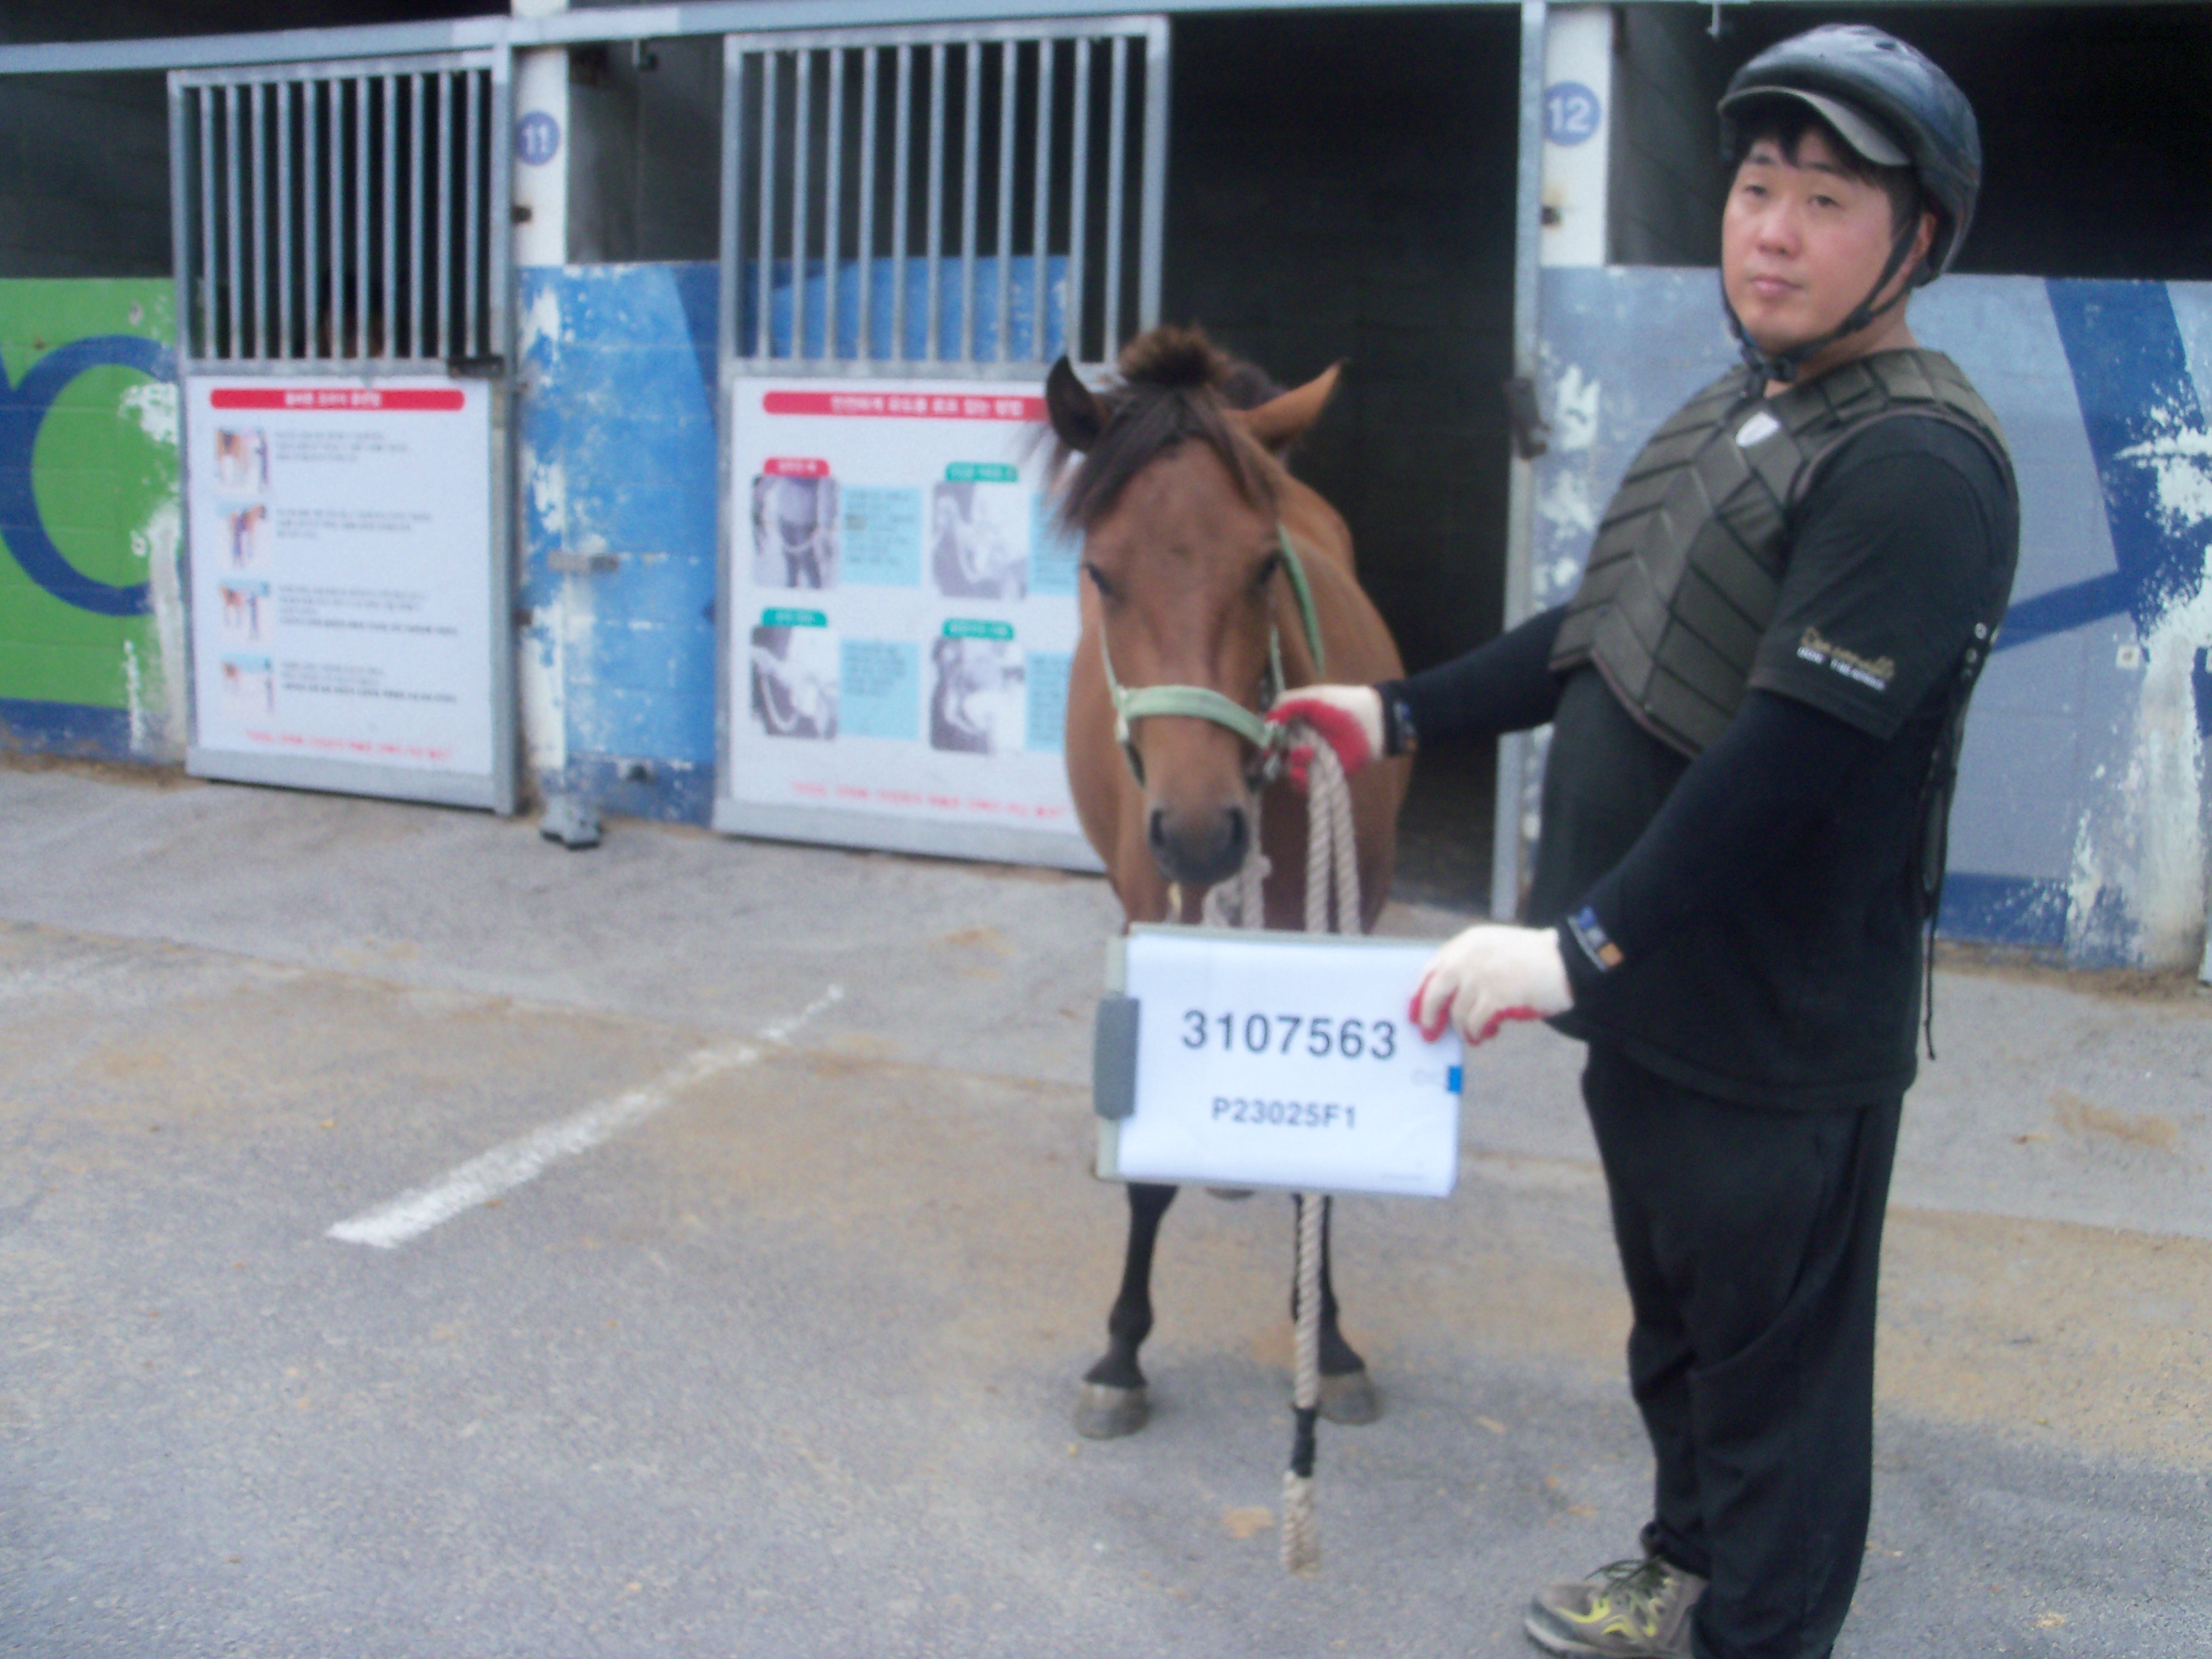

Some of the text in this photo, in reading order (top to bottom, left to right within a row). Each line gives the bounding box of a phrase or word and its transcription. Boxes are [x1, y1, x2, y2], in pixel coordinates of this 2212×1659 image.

[1550, 96, 1590, 132] 12
[523, 124, 549, 154] 11
[1182, 1010, 1396, 1059] 3107563
[1212, 1097, 1355, 1128] P23025F1
